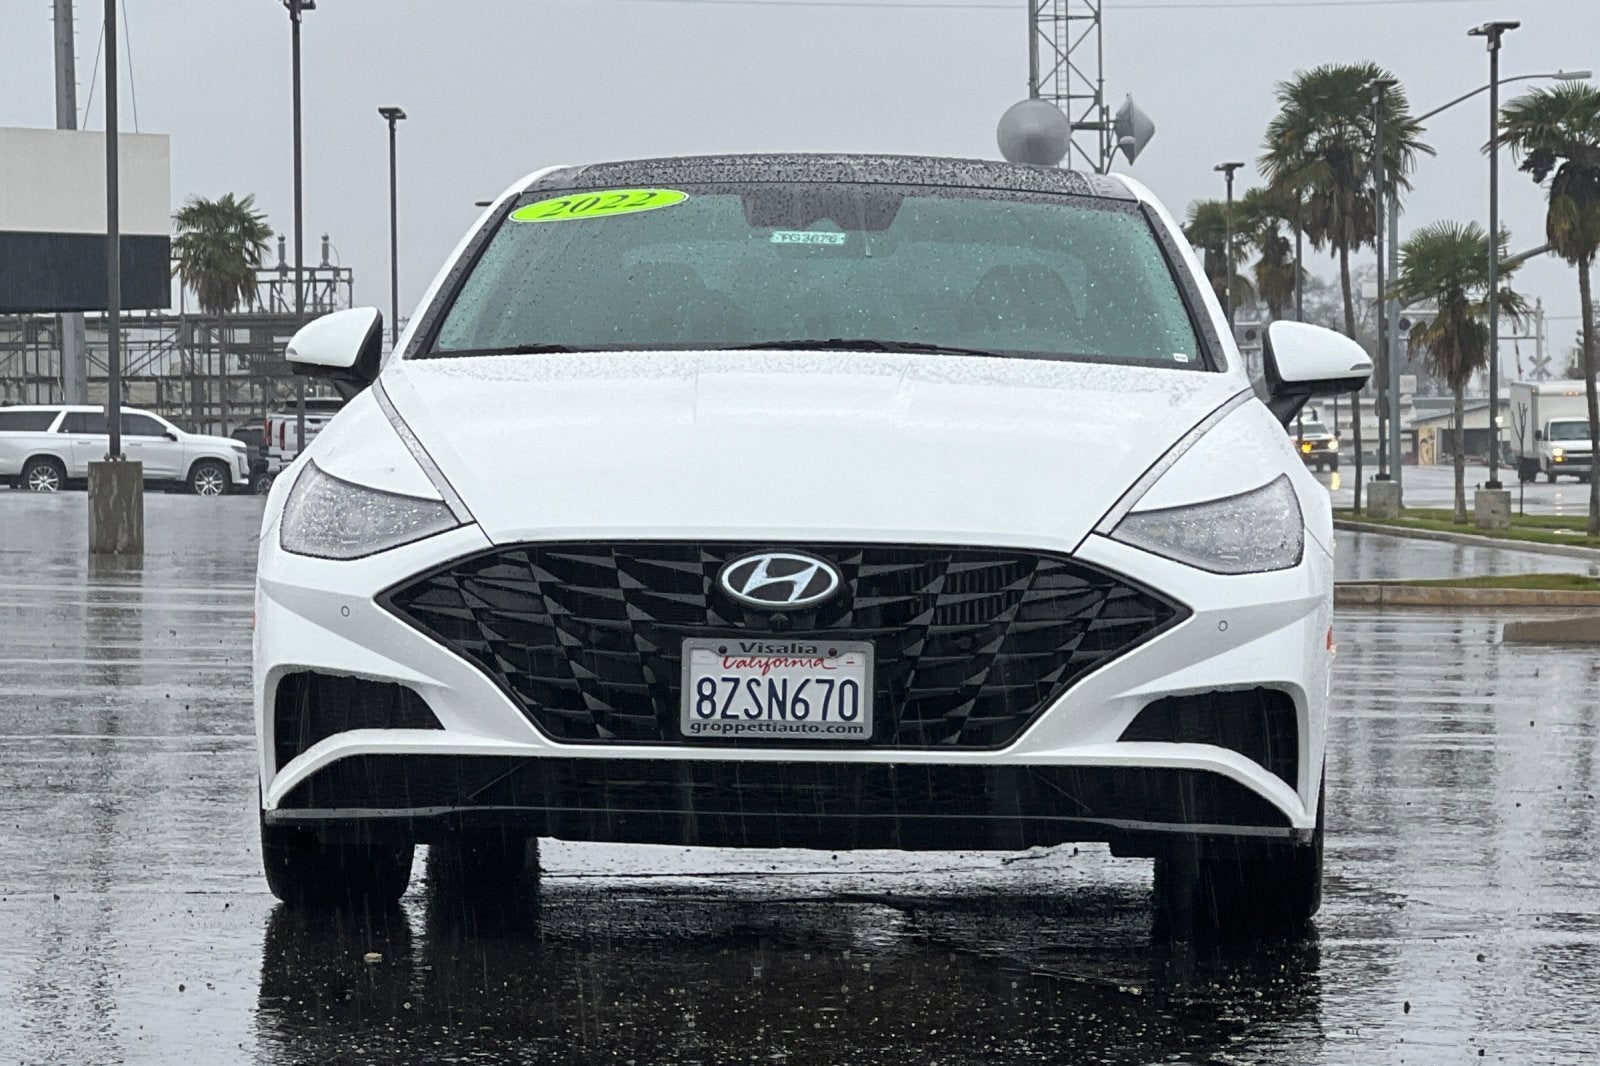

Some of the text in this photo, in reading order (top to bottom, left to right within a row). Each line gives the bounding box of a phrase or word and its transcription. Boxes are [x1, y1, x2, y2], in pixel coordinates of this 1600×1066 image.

[537, 192, 657, 218] 2022
[739, 642, 818, 655] Visalia
[722, 656, 837, 676] California
[696, 676, 859, 721] 8ZSN670
[690, 722, 864, 734] groppettiauto.com
